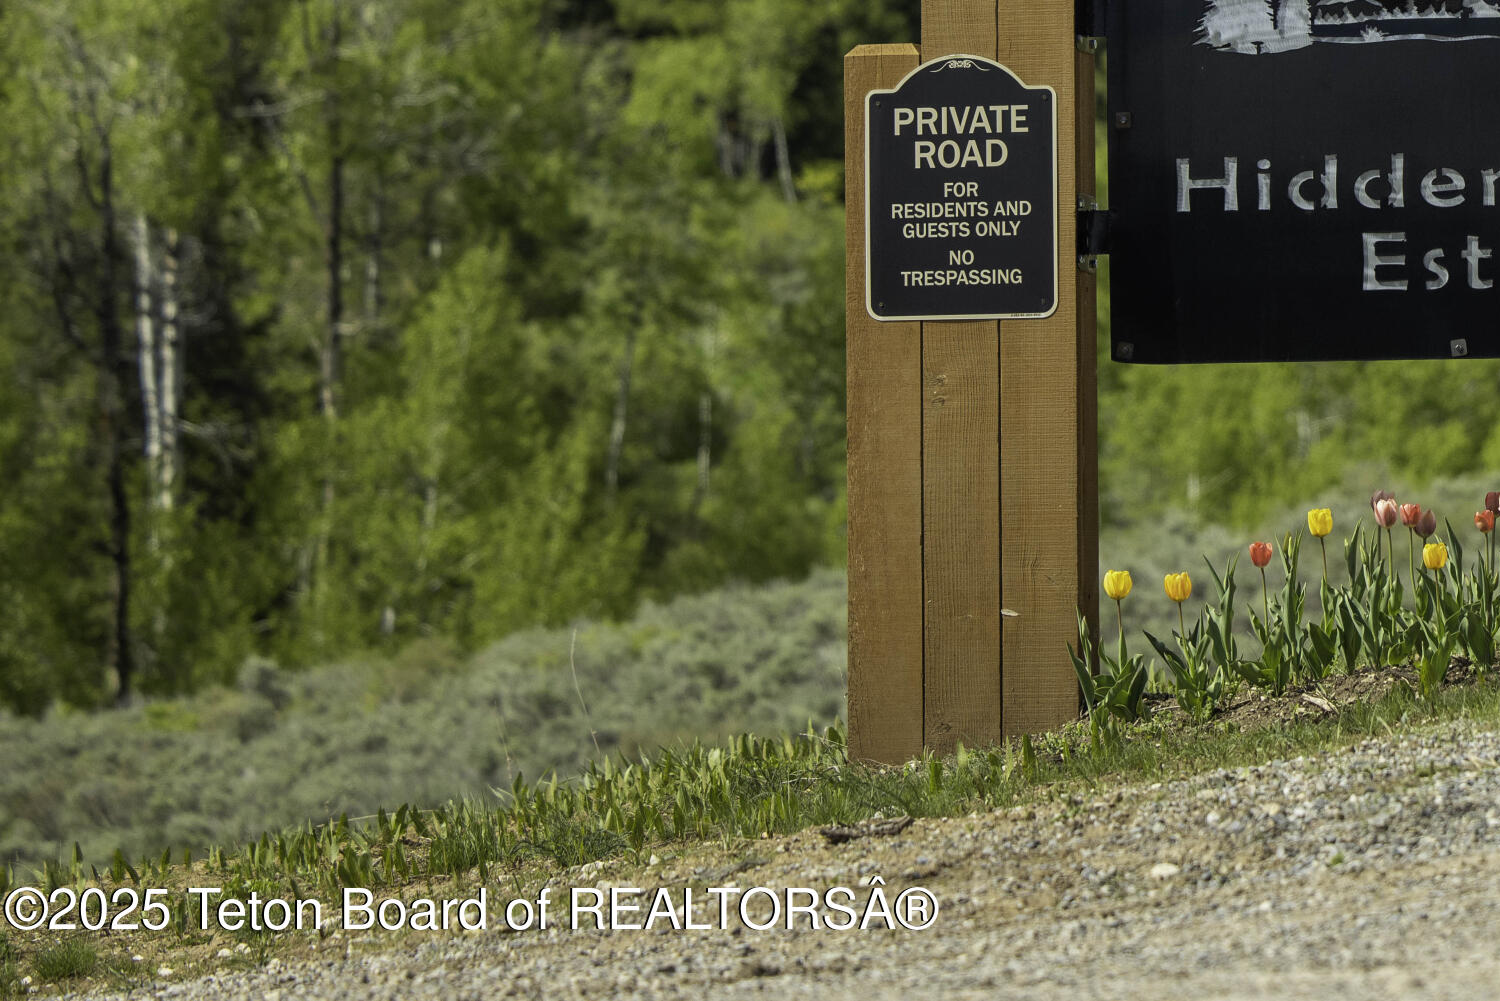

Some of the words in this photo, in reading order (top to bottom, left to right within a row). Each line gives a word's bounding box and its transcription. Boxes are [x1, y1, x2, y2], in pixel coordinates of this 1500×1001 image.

[893, 104, 1029, 136] PRIVATE
[914, 139, 1009, 169] ROAD
[943, 182, 979, 198] FOR
[891, 202, 989, 219] RESIDENTS
[993, 200, 1032, 217] AND
[902, 222, 970, 239] GUESTS
[975, 220, 1021, 237] ONLY
[948, 249, 975, 266] NO
[900, 268, 1023, 287] TRESPASSING
